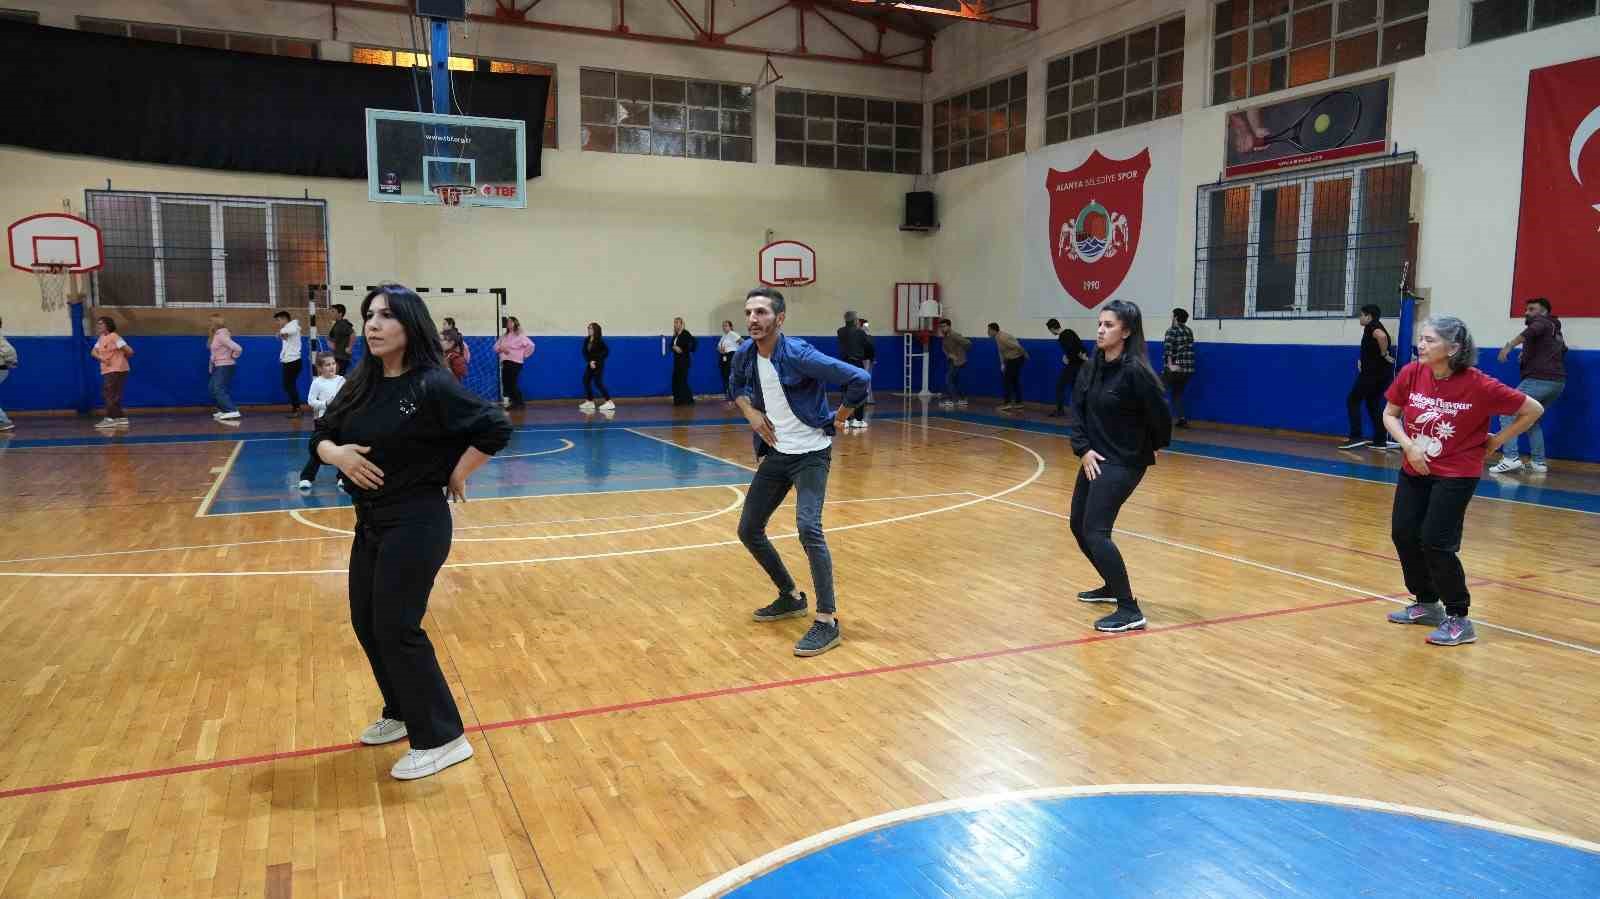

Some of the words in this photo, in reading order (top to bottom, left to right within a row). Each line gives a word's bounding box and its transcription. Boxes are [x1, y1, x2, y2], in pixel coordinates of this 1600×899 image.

[425, 135, 471, 144] www.tbf.org.tr
[1056, 181, 1084, 192] ALANYA
[1117, 170, 1138, 181] SPOR
[495, 187, 517, 197] TBF
[1083, 280, 1100, 290] 1990
